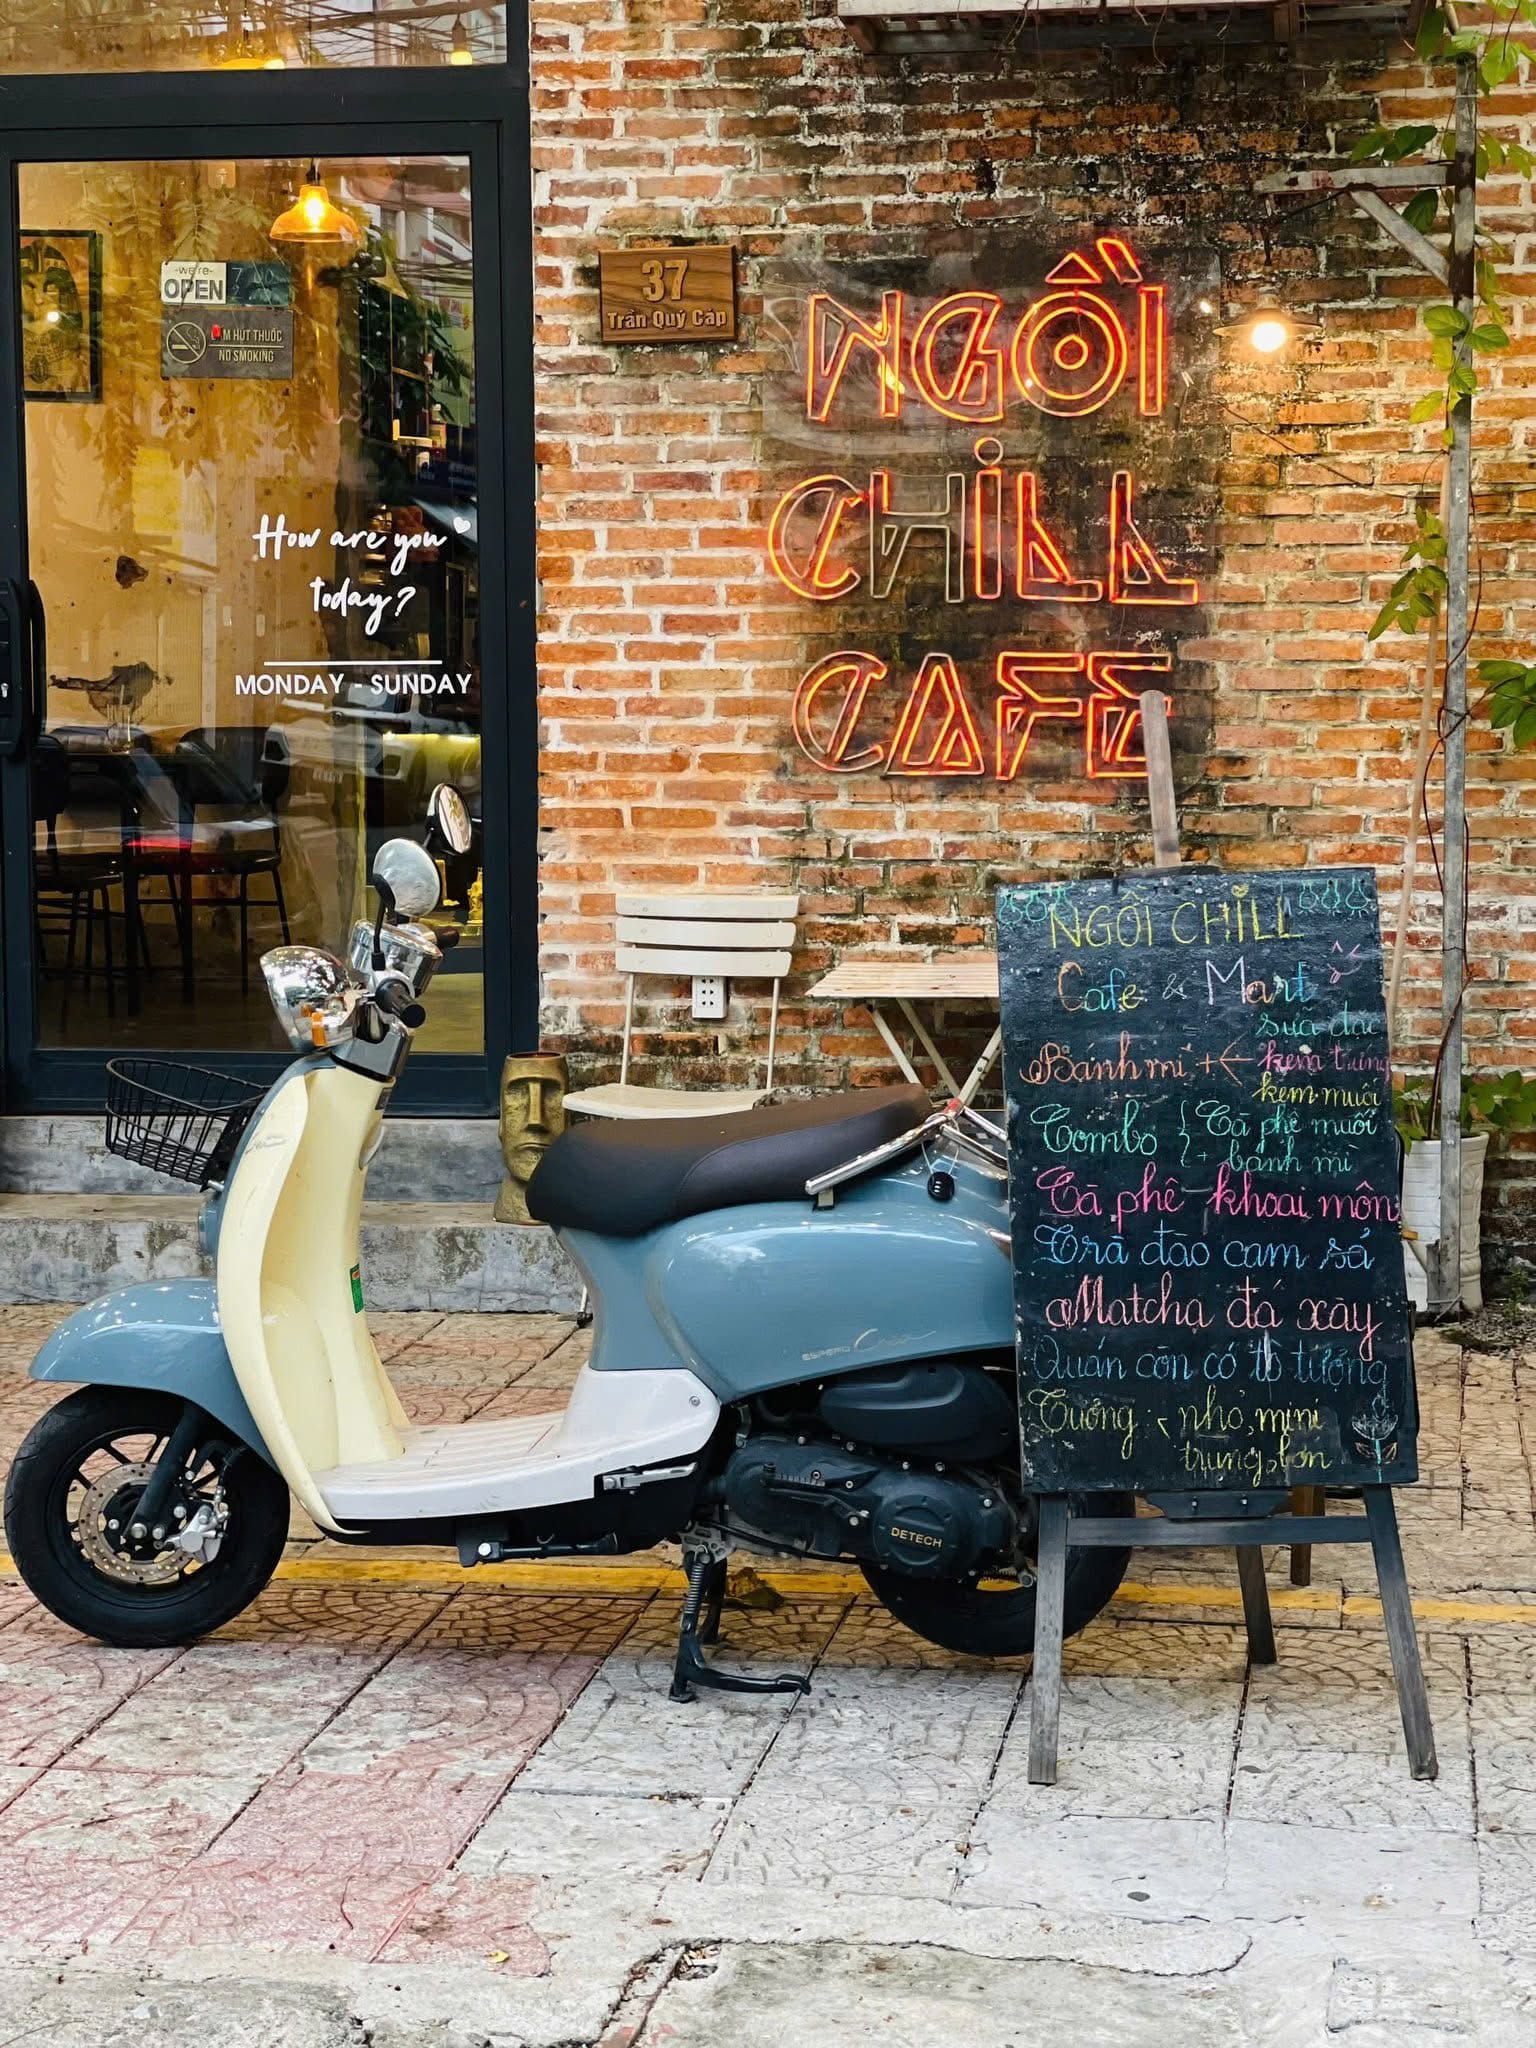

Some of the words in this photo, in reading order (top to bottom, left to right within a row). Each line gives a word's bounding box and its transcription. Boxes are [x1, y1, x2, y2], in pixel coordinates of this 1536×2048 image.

[164, 279, 223, 300] OPEN
[642, 260, 688, 302] 37
[608, 309, 647, 329] Trần
[652, 309, 686, 329] Quý
[692, 308, 727, 327] Cáp
[808, 238, 1164, 422] NGỒI
[219, 351, 231, 362] NO
[233, 351, 274, 363] SMOKING
[252, 513, 321, 560] How
[330, 530, 387, 549] are
[390, 530, 448, 576] you
[309, 576, 416, 636] today?
[235, 673, 344, 695] MONDAY
[370, 673, 472, 695] SUNDAY
[792, 650, 1172, 781] CAFE
[1057, 960, 1145, 1011] Cafe
[1162, 973, 1187, 1000] &
[1205, 955, 1318, 1005] Mart
[1019, 1030, 1142, 1085] Bánh
[1257, 1040, 1323, 1072] kem
[1252, 1071, 1316, 1104] kem
[1030, 1099, 1157, 1156] Combo
[1255, 1104, 1302, 1153] phê
[1311, 1108, 1378, 1136] muối
[1117, 1161, 1184, 1233] phê
[1206, 1161, 1311, 1219] khoai
[1319, 1180, 1400, 1222] môn
[1223, 1240, 1309, 1269] cam
[1046, 1270, 1215, 1328] Matcha
[1226, 1275, 1283, 1329] đá
[1296, 1298, 1383, 1361] xay
[1034, 1335, 1127, 1380] Quán
[1203, 1342, 1237, 1380] có
[1255, 1398, 1323, 1432] mini
[891, 1527, 943, 1548] DETECH
